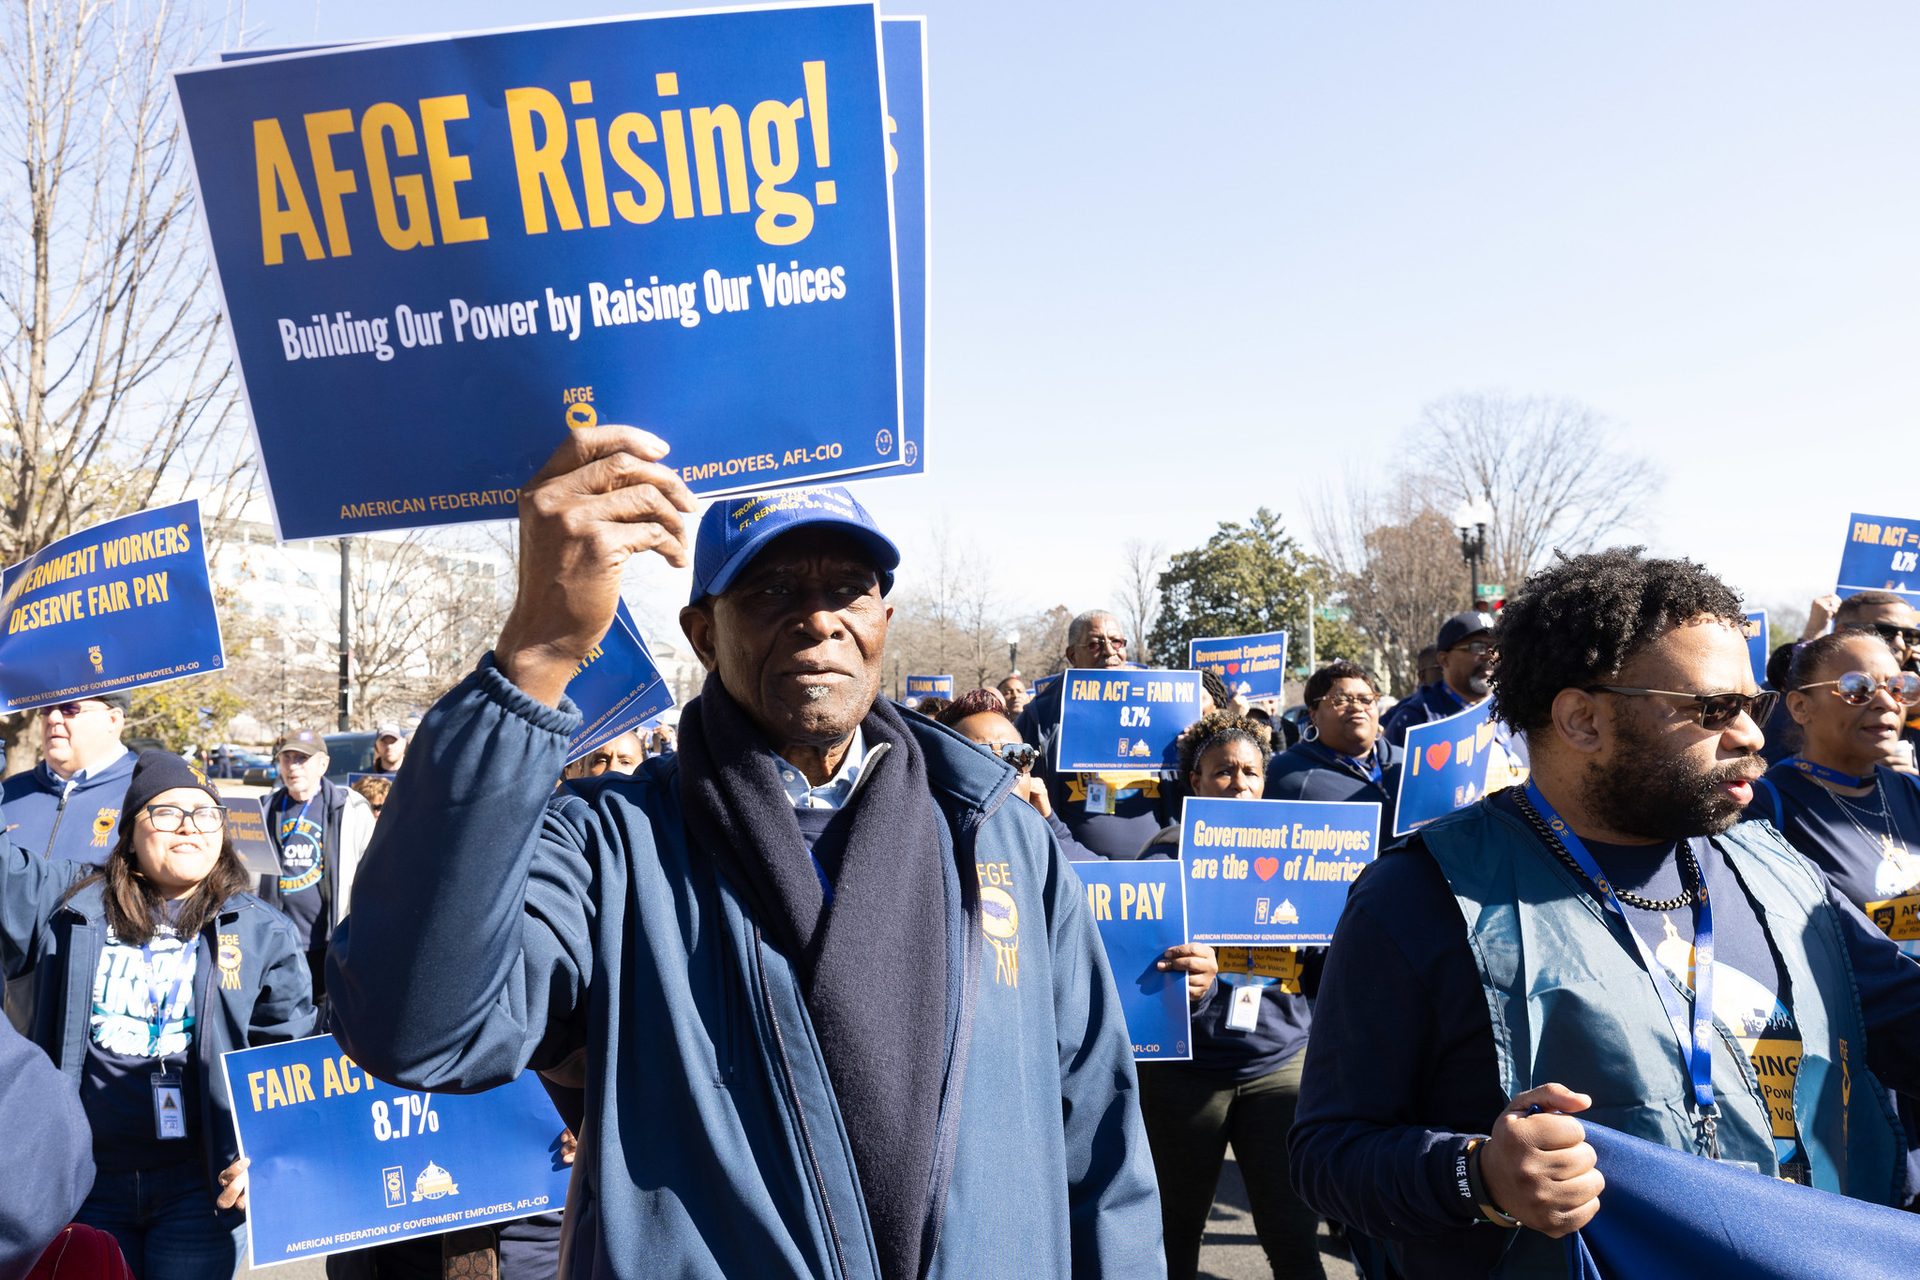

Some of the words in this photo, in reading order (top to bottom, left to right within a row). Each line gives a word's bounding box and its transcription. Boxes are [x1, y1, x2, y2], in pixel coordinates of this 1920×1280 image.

[253, 94, 489, 266] AFGE
[505, 61, 837, 246] Rising!
[277, 311, 395, 362] Building
[395, 304, 444, 349] Our
[449, 298, 539, 343] Power
[545, 287, 581, 341] by
[588, 275, 700, 328] Raising
[703, 268, 752, 314] Our
[756, 260, 847, 308] Voices
[562, 386, 594, 404] AFGE
[340, 497, 426, 520] AMERICAN
[682, 454, 780, 483] EMPLOYEES,
[783, 442, 843, 467] AFL-CIO
[102, 523, 191, 569] WORKERS
[1852, 521, 1882, 545] FAIR
[1881, 525, 1909, 548] ACT
[8, 590, 85, 635] DESERVE
[87, 580, 131, 617] FAIR
[133, 571, 169, 607] PAY
[1195, 646, 1243, 663] Government
[1241, 659, 1251, 674] of
[1251, 657, 1280, 673] America
[7, 693, 42, 707] AMERICAN
[42, 686, 80, 700] FEDERATION
[80, 684, 90, 693] OF
[90, 674, 135, 690] GOVERNMENT
[174, 661, 200, 673] AFL-CIO
[1071, 680, 1102, 701] FAIR
[1103, 681, 1130, 702] ACT
[1147, 681, 1174, 703] FAIR
[1175, 682, 1195, 703] PAY
[1120, 706, 1150, 727] 8.7%
[1412, 746, 1421, 777] I
[1193, 820, 1289, 849] Government
[1290, 823, 1371, 857] Employees
[976, 863, 1013, 886] FGE
[1191, 858, 1219, 880] are
[1222, 853, 1249, 880] the
[1283, 856, 1302, 881] of
[1087, 883, 1113, 921] IR
[1119, 882, 1166, 921] PAY
[218, 934, 240, 946] FGE
[248, 1063, 316, 1113] FAIR
[371, 1093, 440, 1142] 8.7%
[1456, 1155, 1467, 1177] AFGE
[1458, 1178, 1471, 1198] WFP
[286, 1236, 333, 1253] AMERICAN
[335, 1225, 388, 1244] FEDERATION
[389, 1222, 401, 1233] OF
[402, 1211, 463, 1230] GOVERNMENT
[464, 1202, 516, 1219] EMPLOYEES,
[516, 1195, 549, 1210] AFL-CIO
